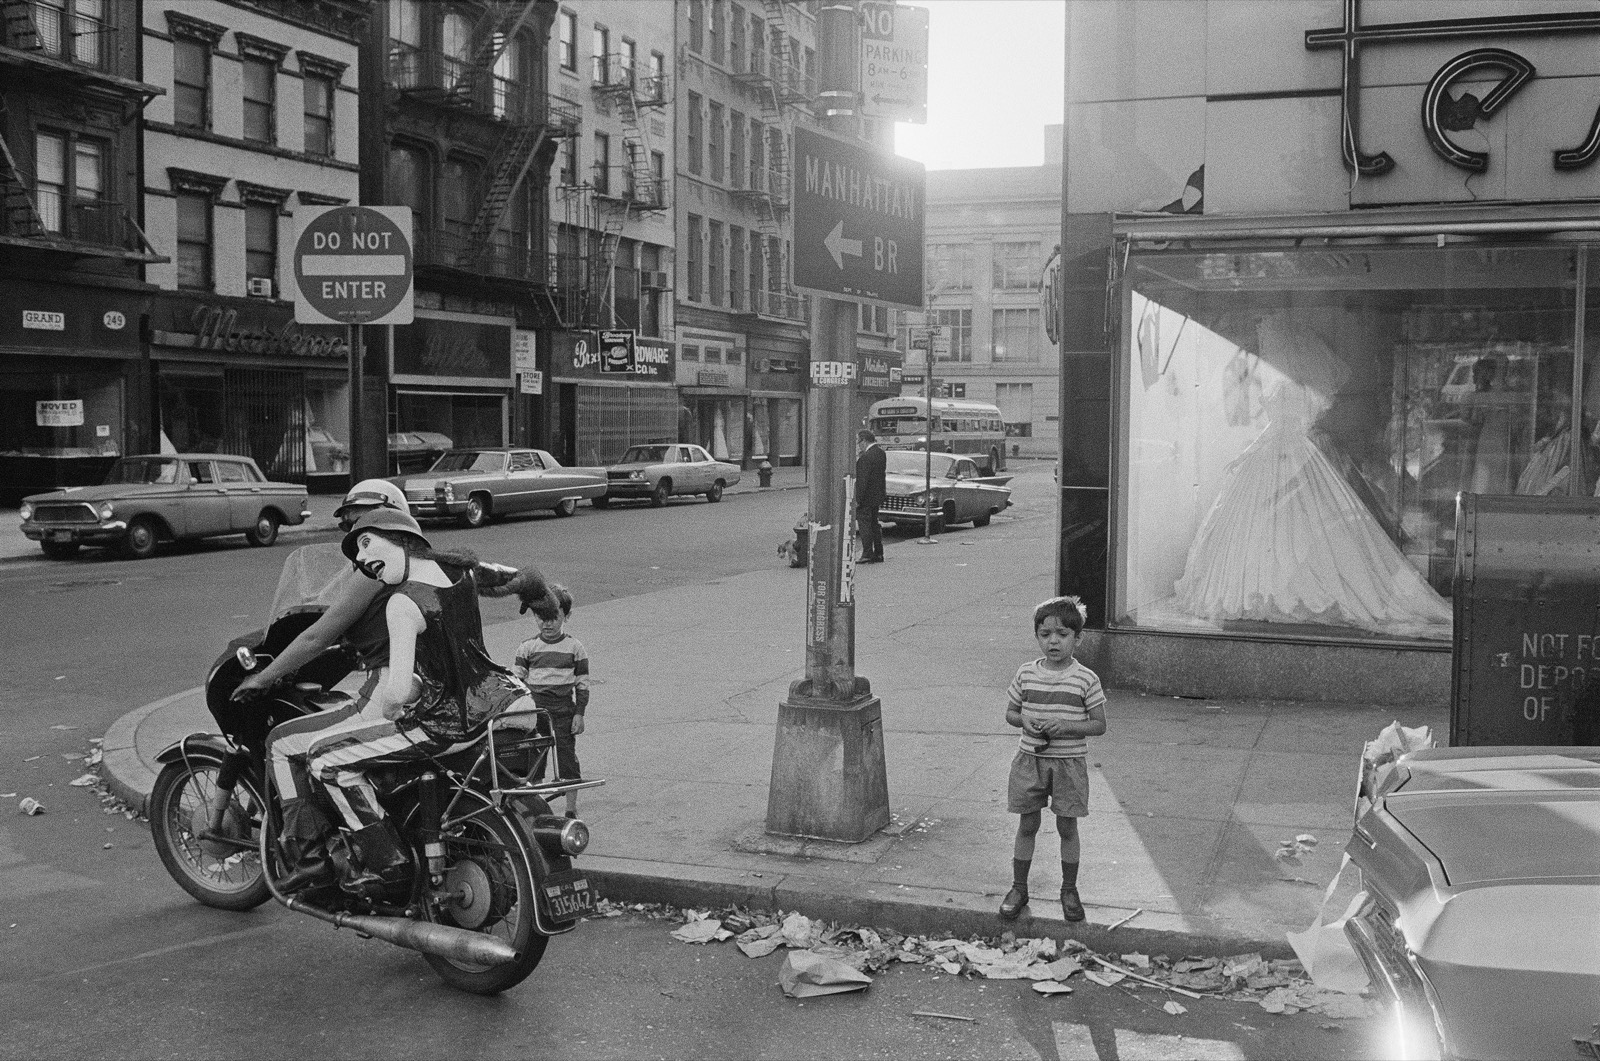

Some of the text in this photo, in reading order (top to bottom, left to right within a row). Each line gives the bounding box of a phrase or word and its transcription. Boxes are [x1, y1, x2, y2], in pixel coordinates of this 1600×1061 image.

[863, 8, 892, 35] NO
[866, 44, 922, 65] PARKING
[806, 155, 915, 220] MANHATTAN
[313, 232, 392, 249] DO NOT
[874, 237, 898, 274] BR
[322, 281, 386, 299] ENTER
[25, 312, 62, 323] GRAND
[105, 314, 124, 327] 249
[636, 346, 668, 363] RDWARE
[522, 372, 541, 380] STORE
[41, 402, 77, 410] MOVED
[815, 580, 826, 643] FOR CONGRESS
[1522, 632, 1569, 659] NOT
[1520, 664, 1600, 689] DEPO
[1523, 696, 1554, 722] OF
[551, 891, 593, 917] 315642
